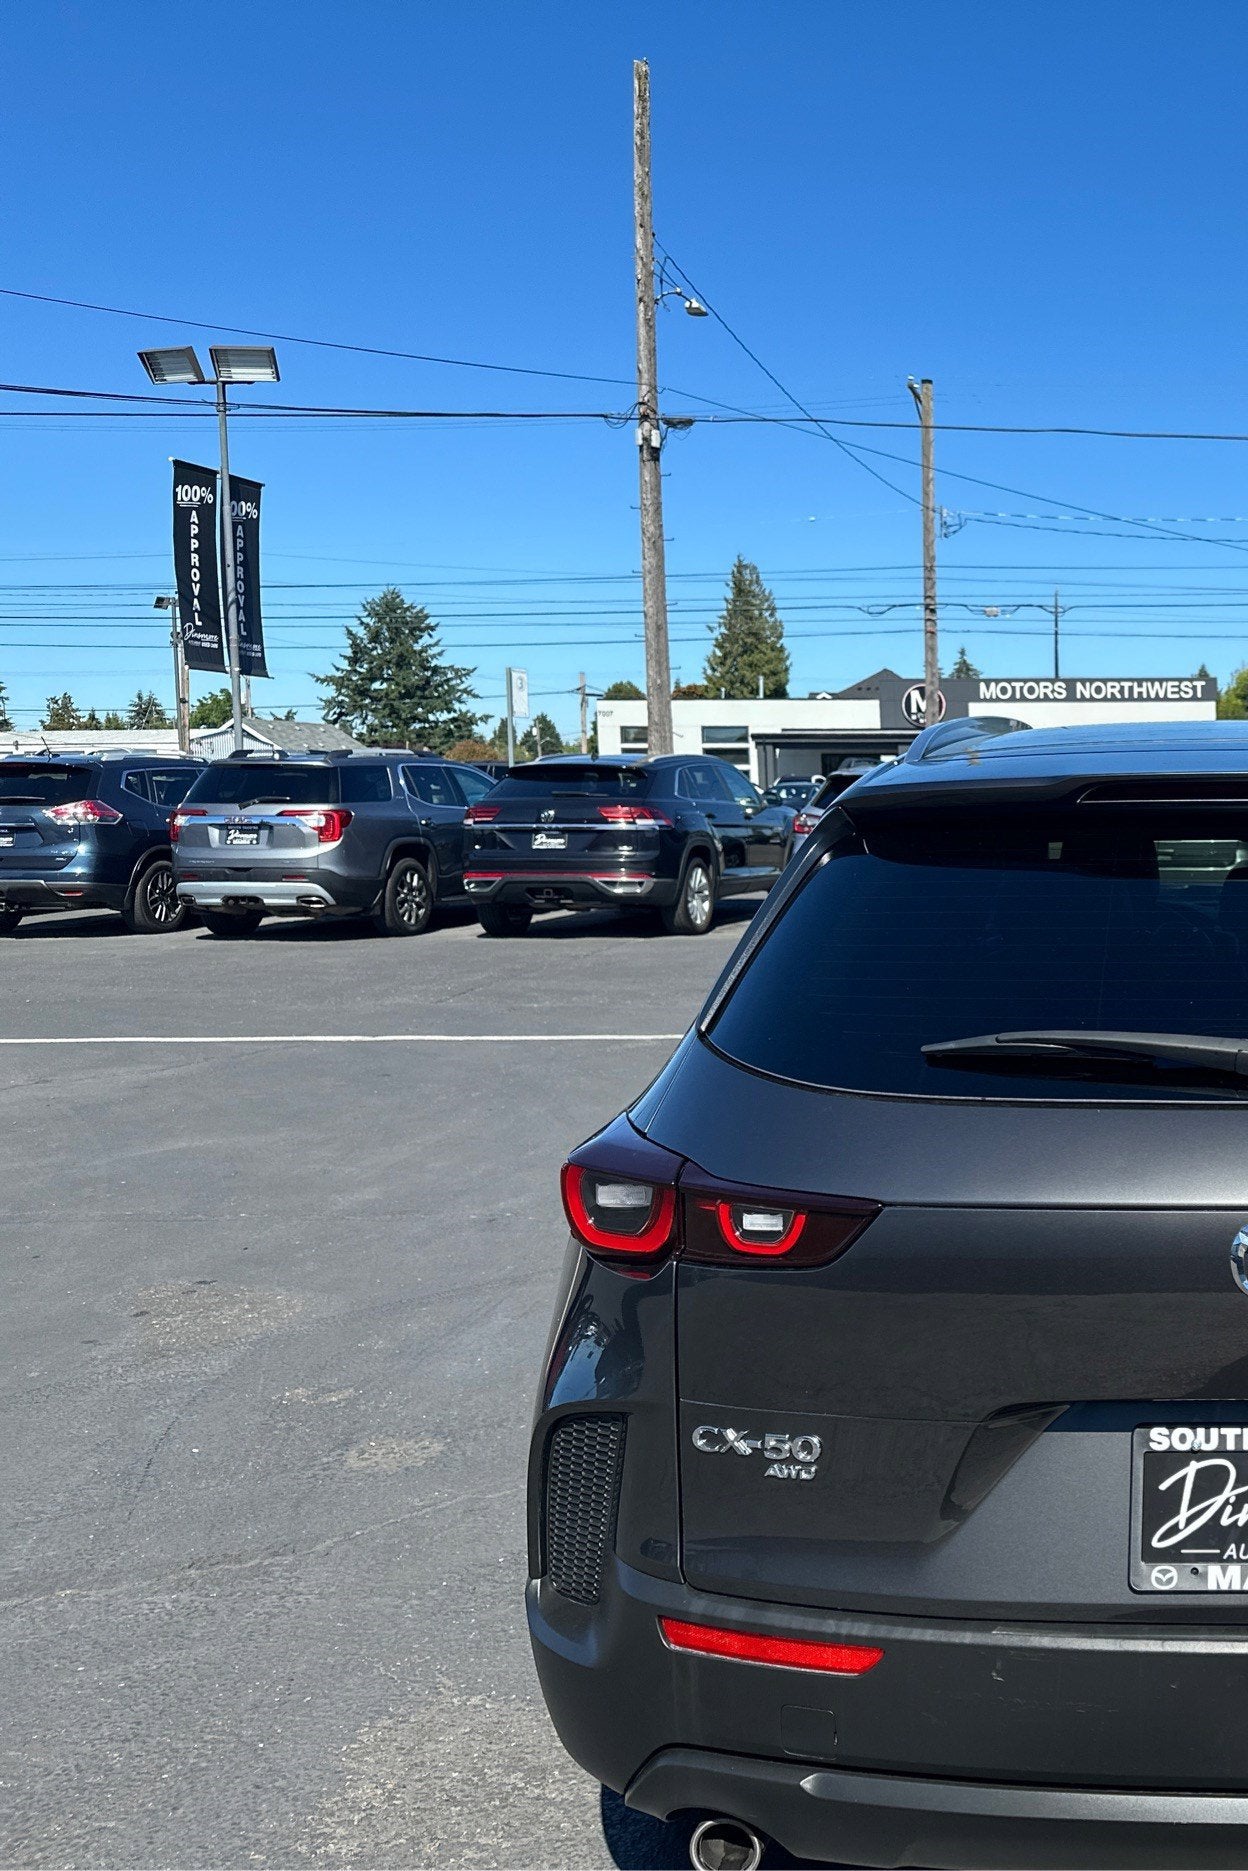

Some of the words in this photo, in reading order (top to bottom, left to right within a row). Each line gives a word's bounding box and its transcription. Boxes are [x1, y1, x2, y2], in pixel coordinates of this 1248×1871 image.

[175, 485, 214, 504] 100%
[229, 500, 258, 519] 00%
[189, 509, 202, 626] APPROVAL
[236, 524, 247, 636] APPROVAL
[979, 681, 1067, 700] MOTORS
[1076, 681, 1206, 699] NORTHWEST
[691, 1425, 822, 1462] CX-50
